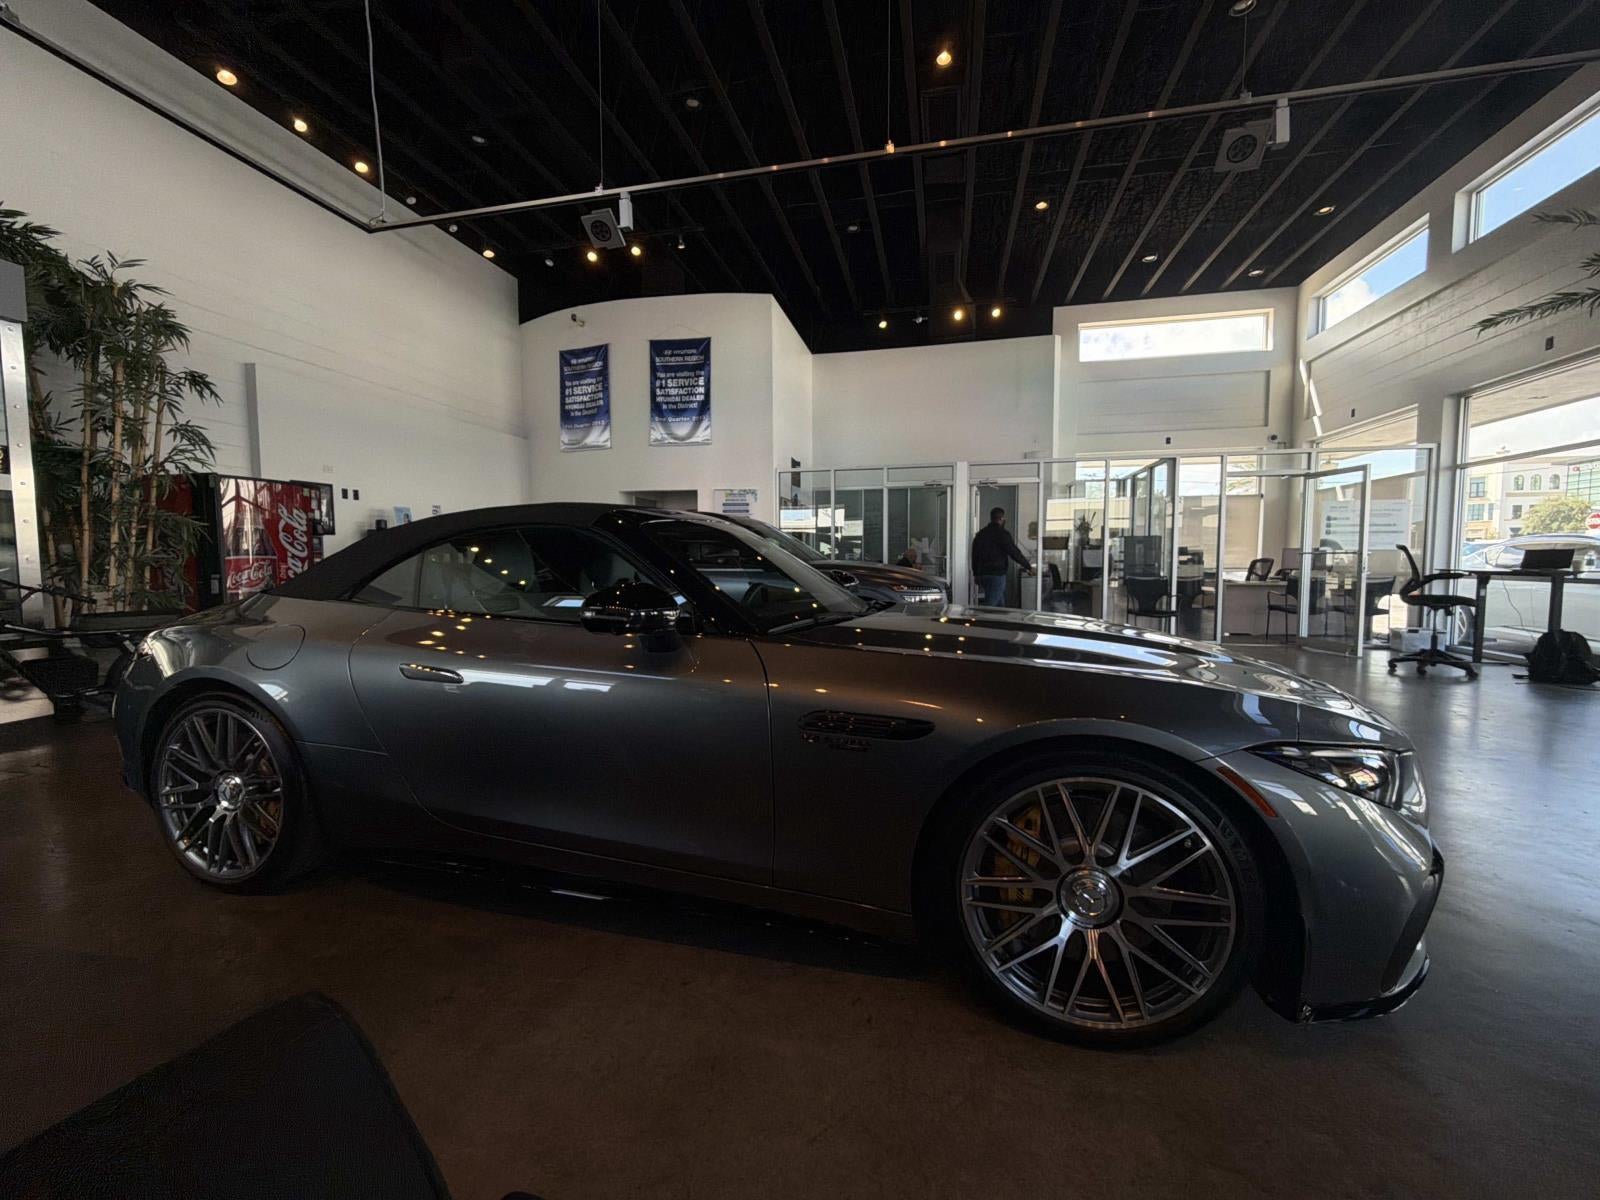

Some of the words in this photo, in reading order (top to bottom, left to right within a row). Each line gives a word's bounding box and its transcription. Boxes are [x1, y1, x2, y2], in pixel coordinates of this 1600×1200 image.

[667, 377, 704, 387] SERVICE
[573, 384, 603, 395] SERVICE
[656, 387, 704, 395] SATISFACTION
[565, 392, 603, 403] SATISFACTION
[586, 400, 604, 408] DEALER
